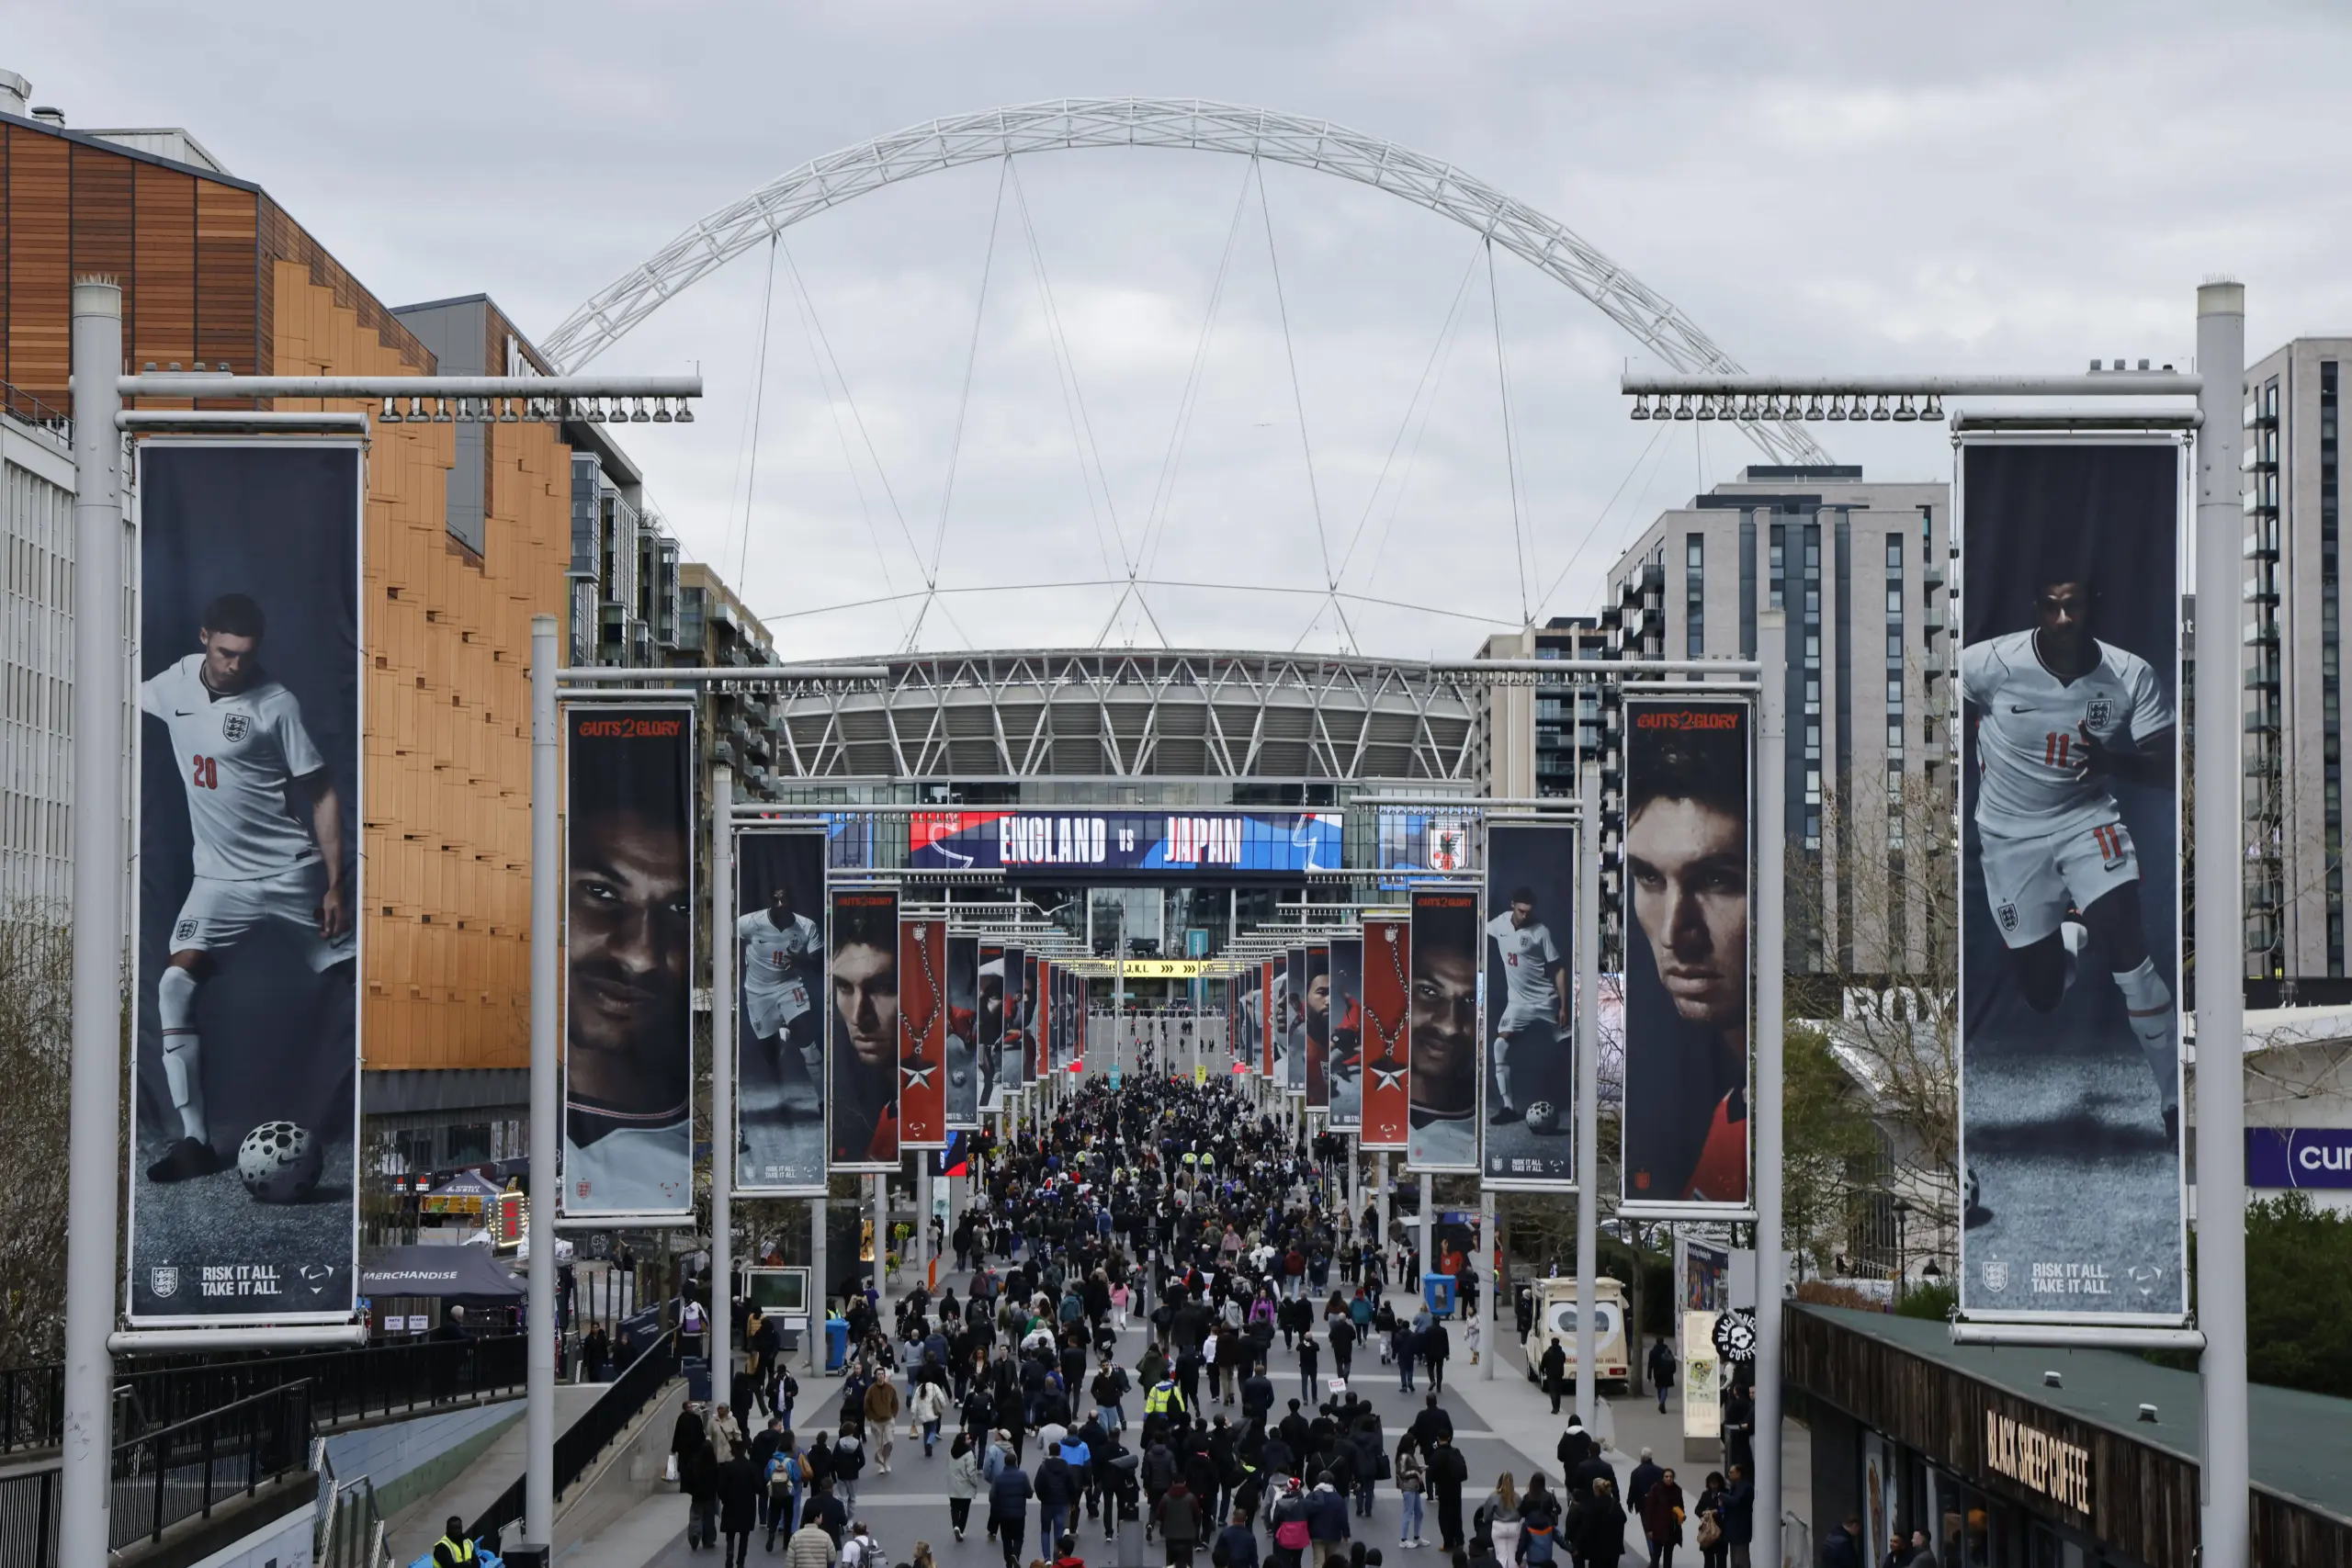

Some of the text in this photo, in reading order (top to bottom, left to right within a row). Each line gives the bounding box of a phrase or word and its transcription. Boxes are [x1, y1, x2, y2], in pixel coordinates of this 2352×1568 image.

[2045, 732, 2070, 768] 11
[193, 754, 218, 790] 20
[999, 816, 1241, 864] ENGLAND VS JAPAN
[2093, 826, 2123, 861] 11
[1508, 952, 1519, 967] 20
[202, 1265, 281, 1280] RISK IT ALL.
[364, 1270, 458, 1281] MERCHANDISE
[2032, 1263, 2109, 1279] RISK IT ALL.
[200, 1280, 282, 1296] TAKE IT ALL.
[2031, 1278, 2111, 1294] TAKE IT ALL.
[1987, 1409, 2090, 1516] BLACK SHEEP COFFEE
